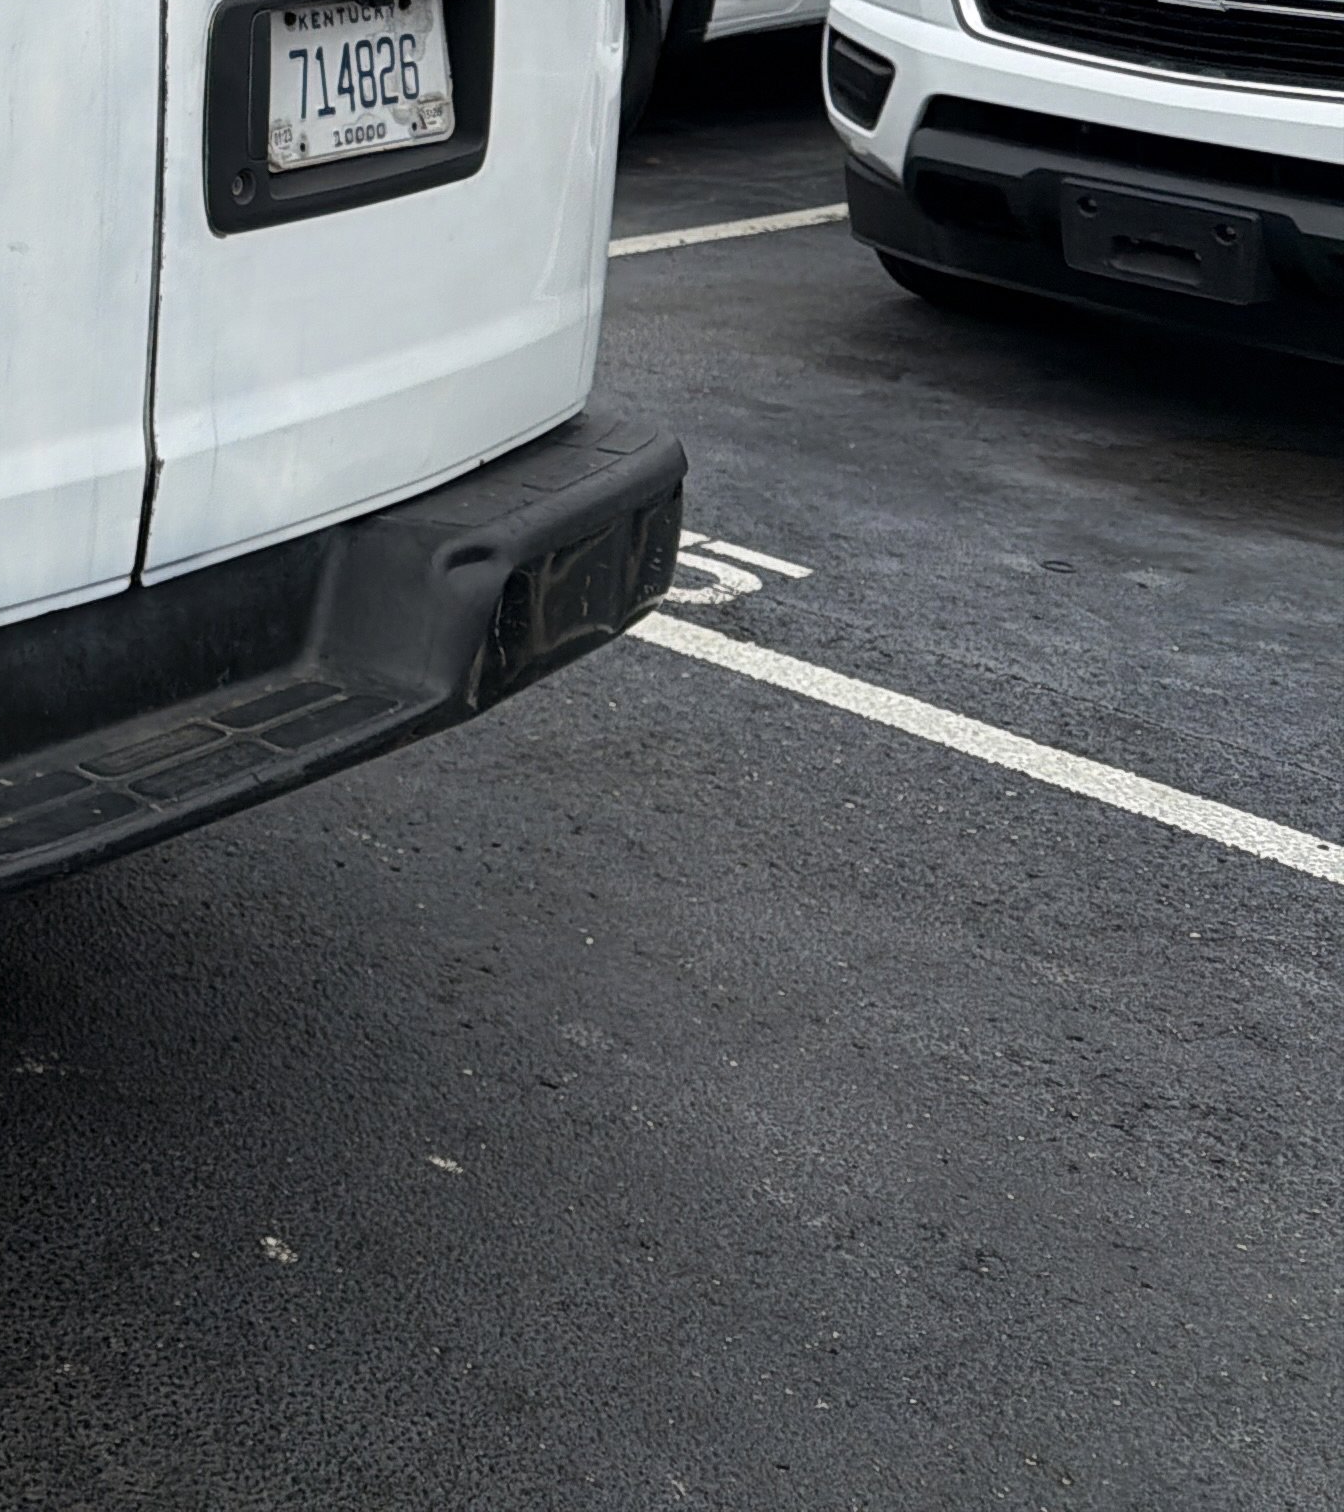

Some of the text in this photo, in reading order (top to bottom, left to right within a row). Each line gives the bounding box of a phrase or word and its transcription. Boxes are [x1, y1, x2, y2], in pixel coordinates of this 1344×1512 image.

[298, 5, 396, 30] KENTUCKY
[289, 33, 420, 119] 714826
[332, 122, 387, 148] 10000
